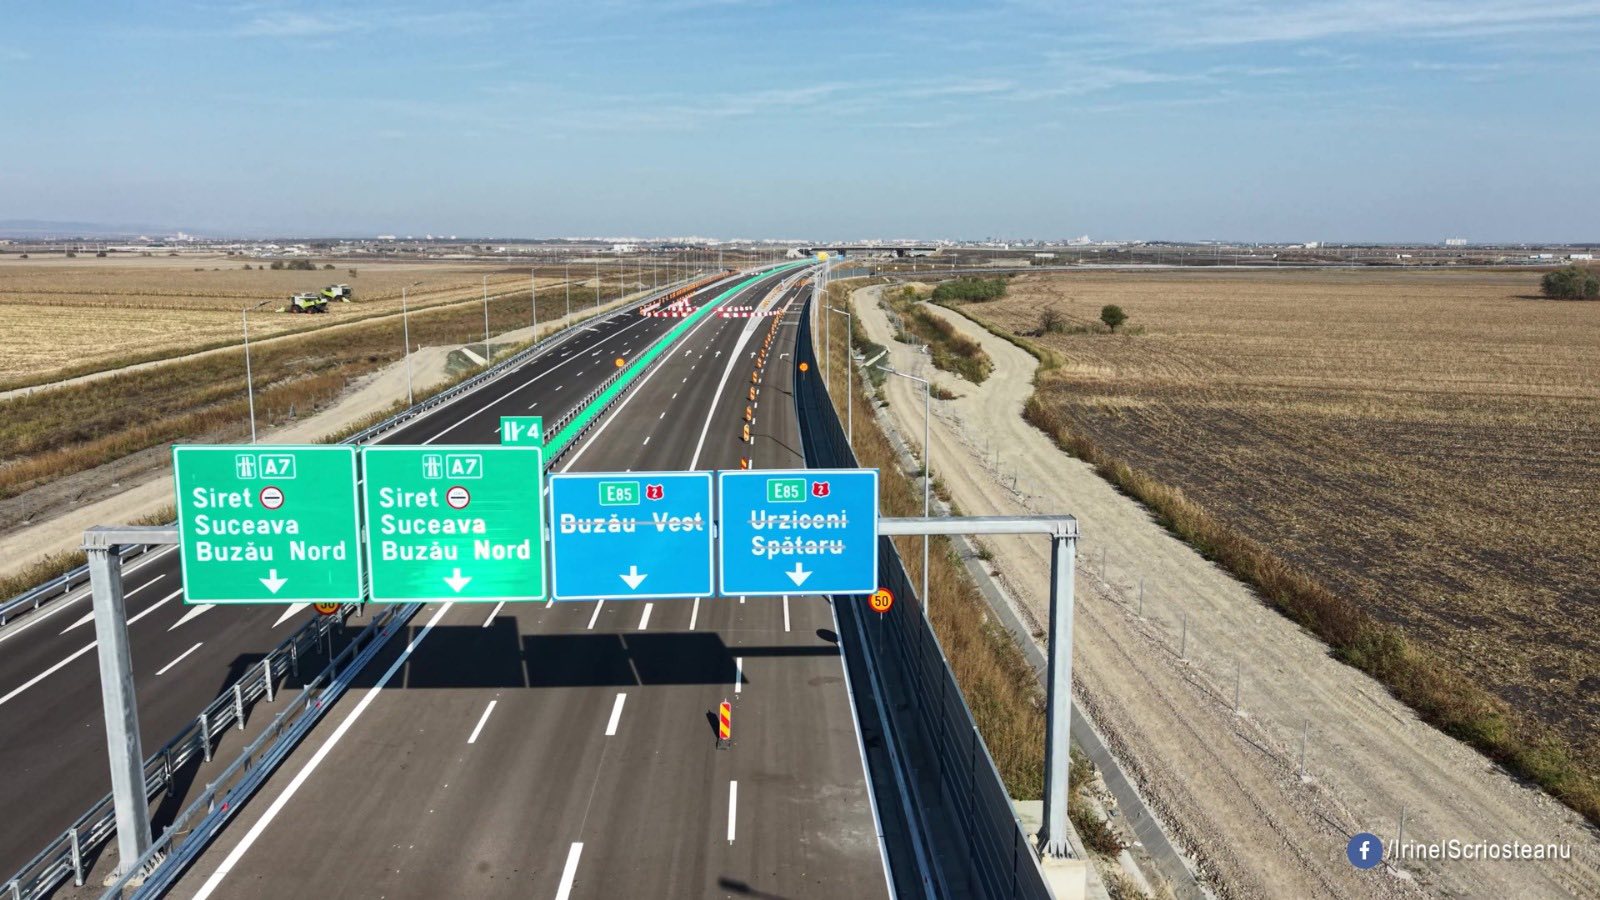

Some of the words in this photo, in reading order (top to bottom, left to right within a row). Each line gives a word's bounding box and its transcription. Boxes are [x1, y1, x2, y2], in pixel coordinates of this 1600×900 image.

[527, 423, 540, 439] 4
[265, 458, 291, 475] A7
[451, 458, 478, 475] A7
[192, 487, 253, 508] Siret
[379, 487, 439, 508] Siret
[607, 485, 632, 502] E85
[651, 487, 659, 498] 2
[774, 482, 799, 499] E85
[818, 485, 824, 495] 2
[194, 514, 299, 535] Suceava
[381, 514, 486, 535] Suceava
[560, 513, 636, 534] Buzău
[652, 512, 704, 533] Vest
[751, 509, 847, 530] Urziceni
[196, 541, 274, 562] Buzău
[289, 540, 347, 562] Nord
[382, 541, 458, 561] Buzău
[474, 539, 531, 561] Nord
[751, 535, 843, 560] Spătaru
[875, 595, 889, 606] 50
